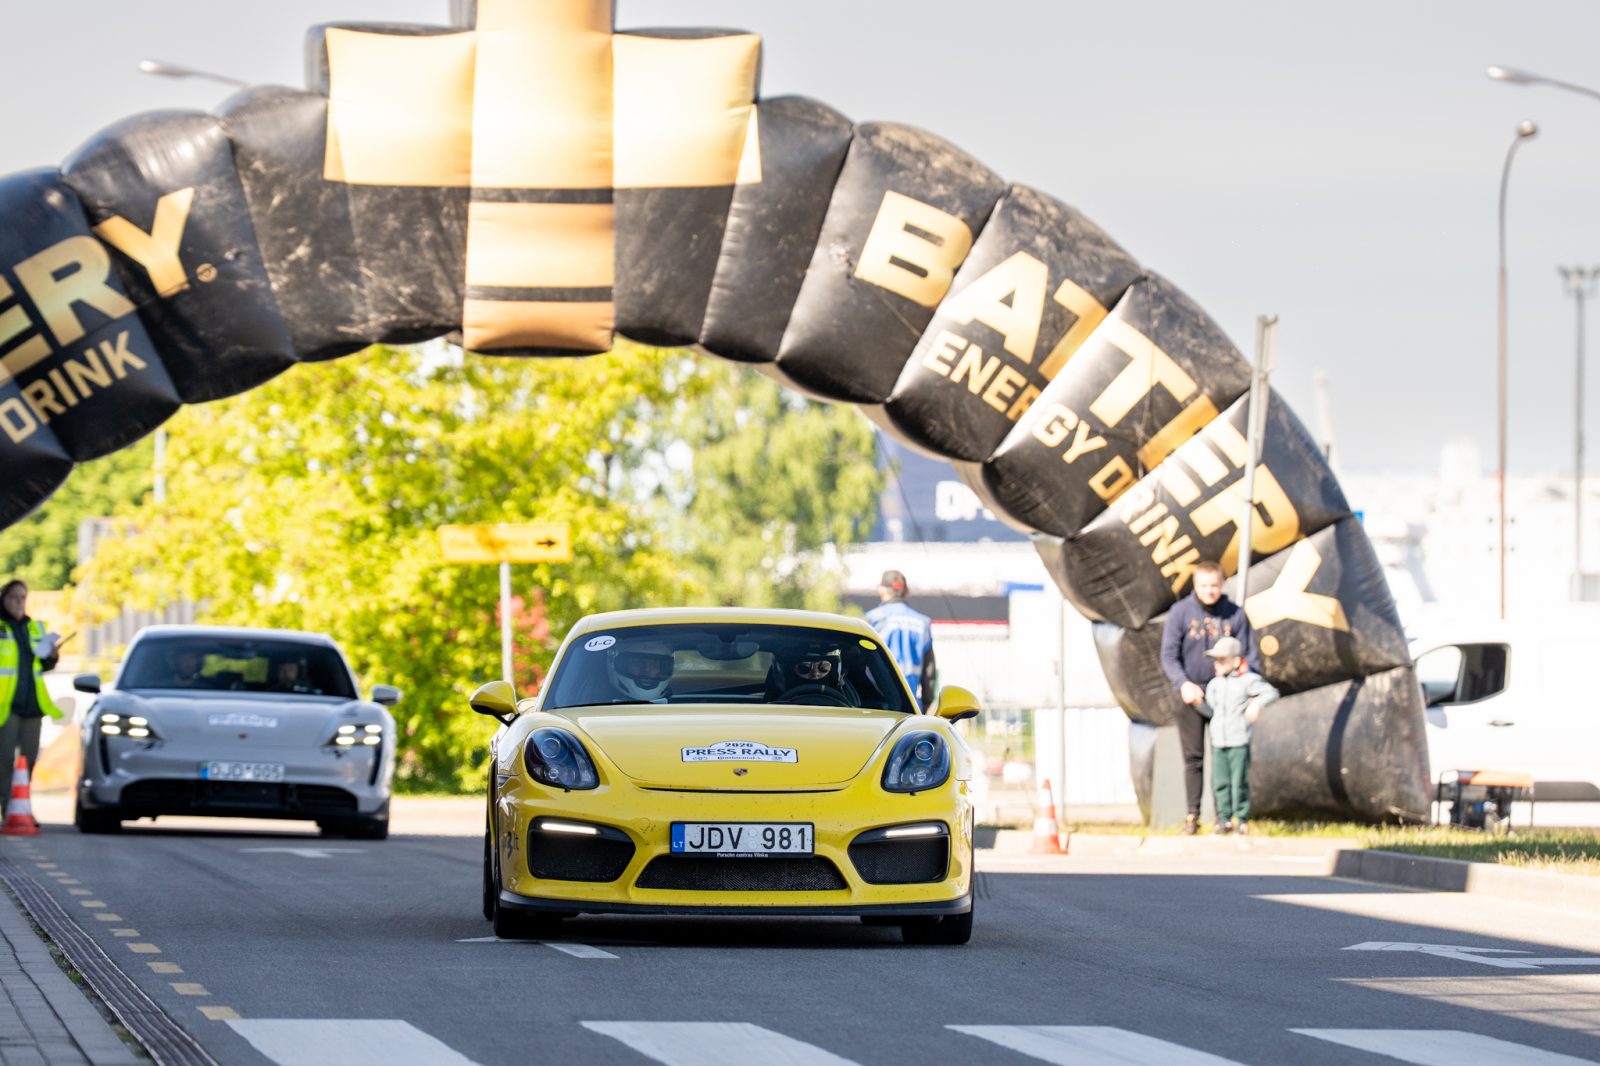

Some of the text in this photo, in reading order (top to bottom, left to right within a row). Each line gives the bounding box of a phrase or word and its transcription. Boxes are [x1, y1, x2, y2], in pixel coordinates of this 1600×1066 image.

[0, 330, 147, 445] DRINK
[854, 190, 1350, 630] BATTERY
[685, 748, 791, 757] PRESS RALLY
[688, 827, 806, 850] JDV 981
